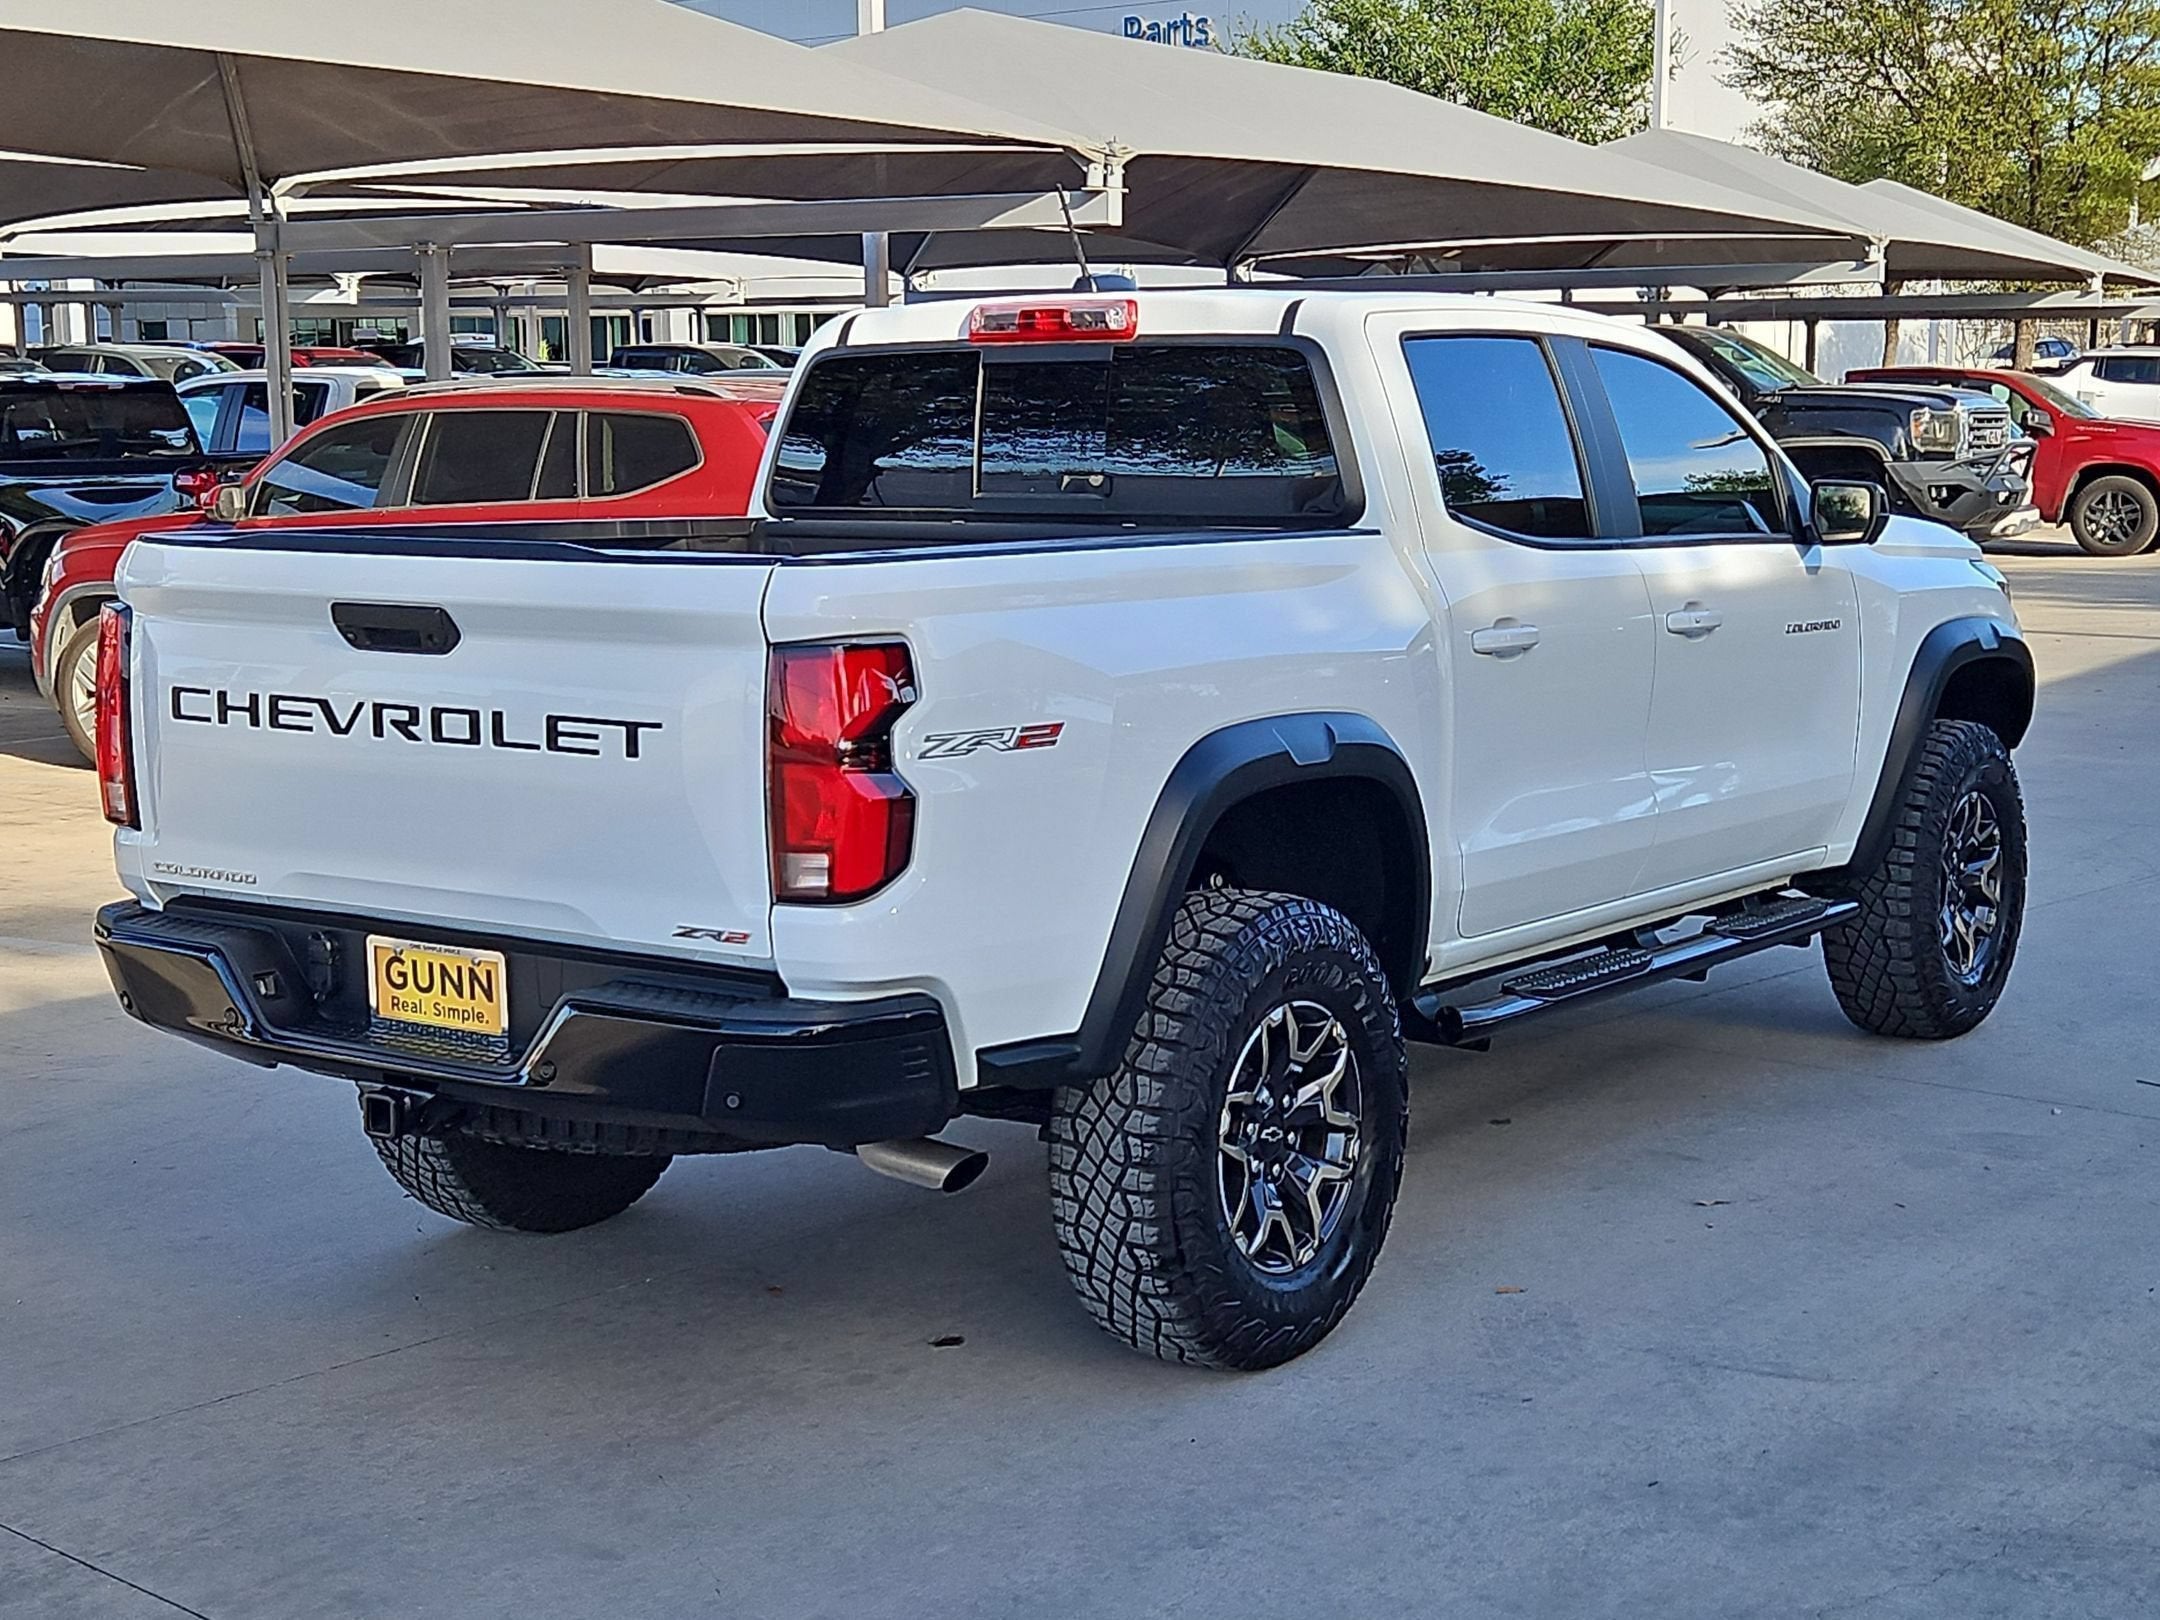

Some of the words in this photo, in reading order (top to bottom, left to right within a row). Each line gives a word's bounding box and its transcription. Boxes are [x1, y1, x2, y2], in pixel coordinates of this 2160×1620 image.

[1123, 12, 1210, 46] Parts
[1785, 619, 1841, 634] COLORADO
[171, 686, 663, 759] CHEVROLET
[917, 722, 1065, 760] ZR2
[154, 862, 257, 885] COLORADO
[671, 925, 751, 944] ZR2
[384, 955, 494, 1004] GUNN
[390, 995, 427, 1016] Real.
[432, 1002, 490, 1025] Simple.
